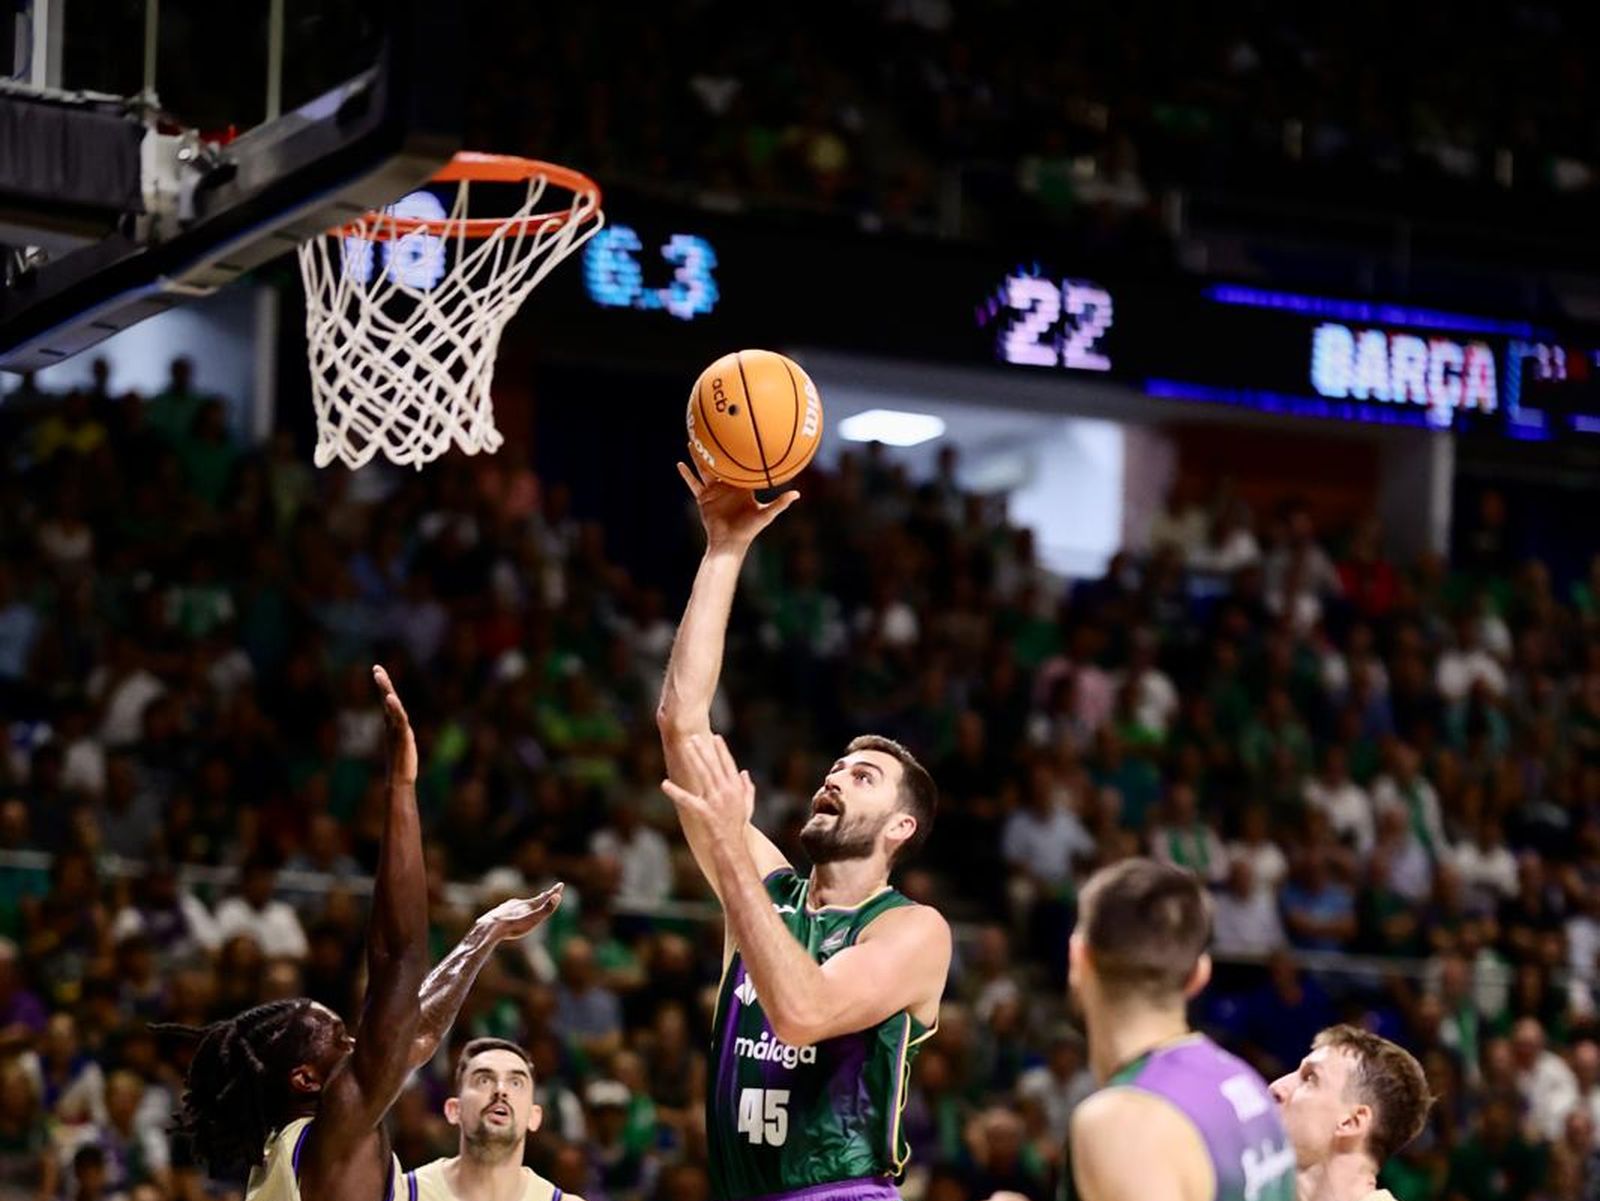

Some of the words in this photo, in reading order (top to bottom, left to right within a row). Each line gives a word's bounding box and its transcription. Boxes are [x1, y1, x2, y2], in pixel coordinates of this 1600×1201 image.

[1004, 274, 1113, 371] 22
[712, 378, 728, 413] acb
[1312, 323, 1498, 428] BARÇA
[738, 1088, 790, 1147] 45
